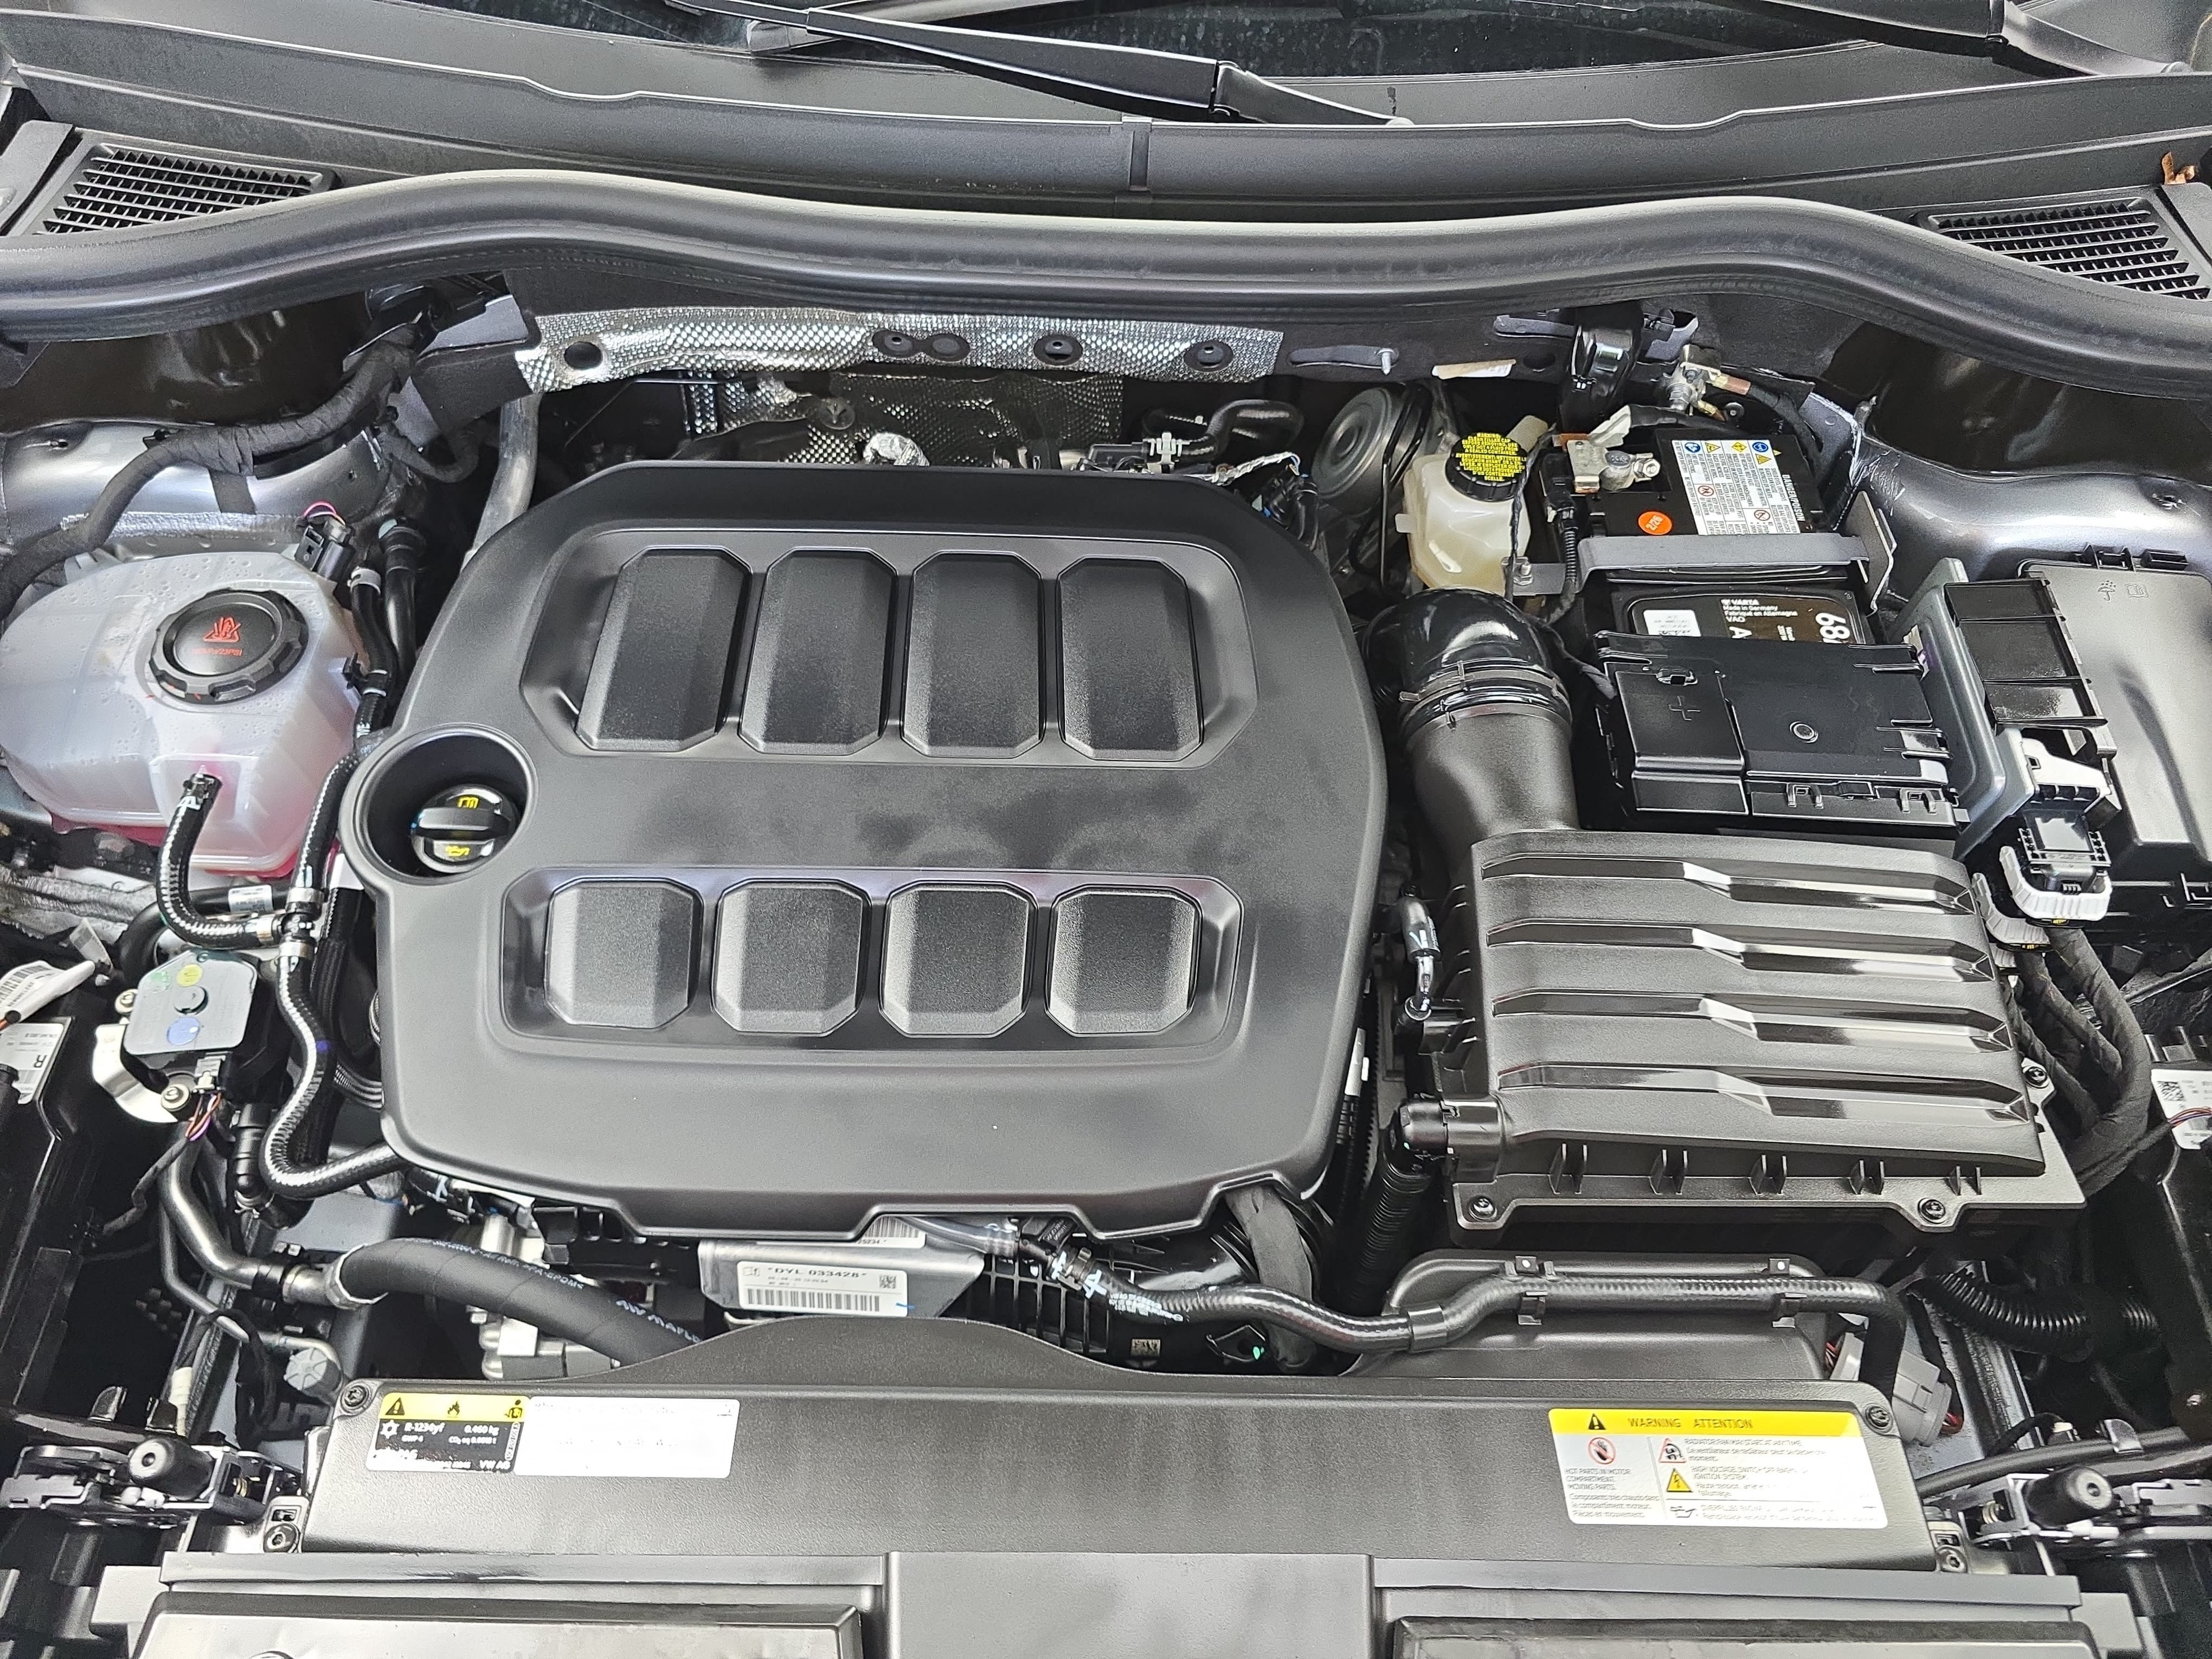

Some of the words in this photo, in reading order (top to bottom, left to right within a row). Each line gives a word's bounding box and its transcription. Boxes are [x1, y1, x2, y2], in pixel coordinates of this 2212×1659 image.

[1780, 474, 1805, 520] DANGER/POISON
[1628, 1418, 1681, 1428] WARNING
[1693, 1418, 1753, 1429] ATTENTION
[480, 1459, 496, 1469] VW
